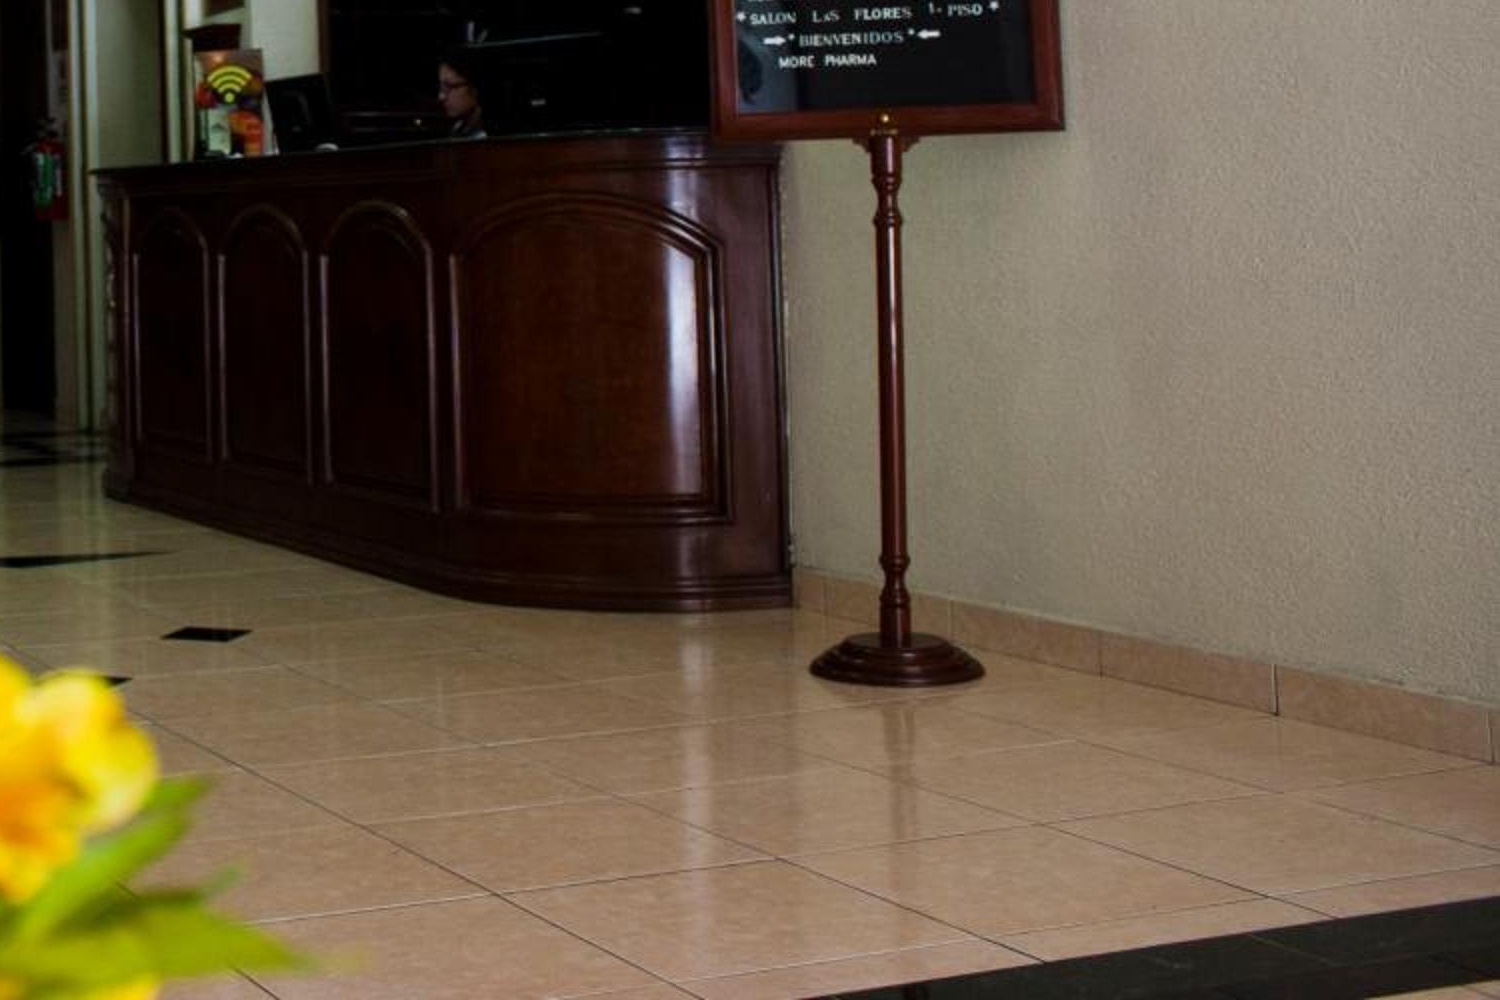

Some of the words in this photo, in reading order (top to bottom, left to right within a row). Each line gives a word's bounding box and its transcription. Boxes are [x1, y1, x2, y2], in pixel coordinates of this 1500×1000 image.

[749, 11, 797, 25] SALON
[853, 6, 913, 21] FLORES
[947, 3, 983, 16] PISO
[799, 31, 904, 47] BIENVENIDOS
[824, 54, 877, 67] PHARMA
